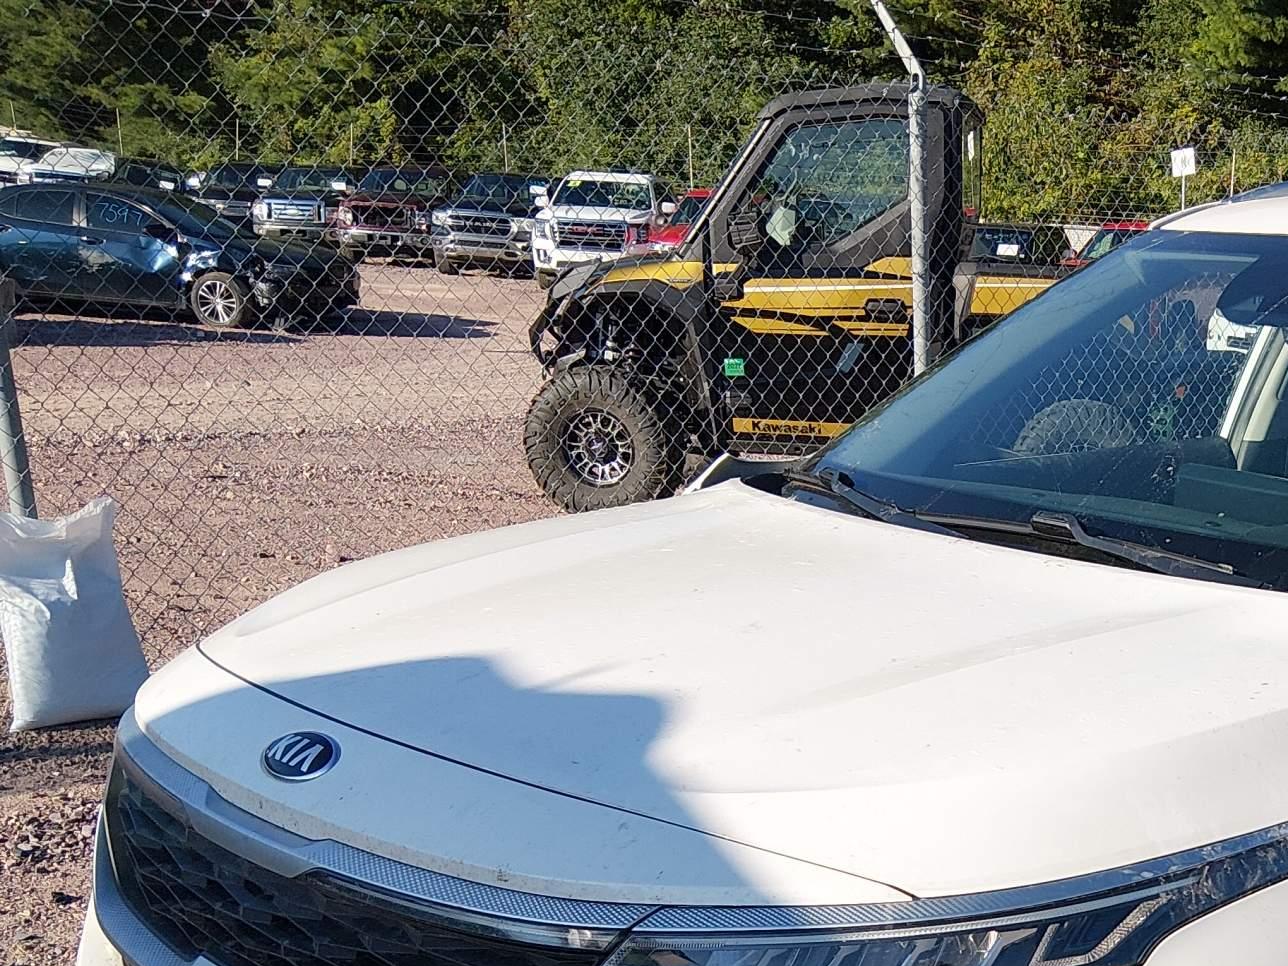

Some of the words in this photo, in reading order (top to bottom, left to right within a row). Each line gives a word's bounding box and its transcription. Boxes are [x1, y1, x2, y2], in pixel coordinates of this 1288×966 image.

[95, 202, 143, 227] 7597
[751, 420, 822, 434] Kawasaki
[267, 734, 325, 772] KIA
